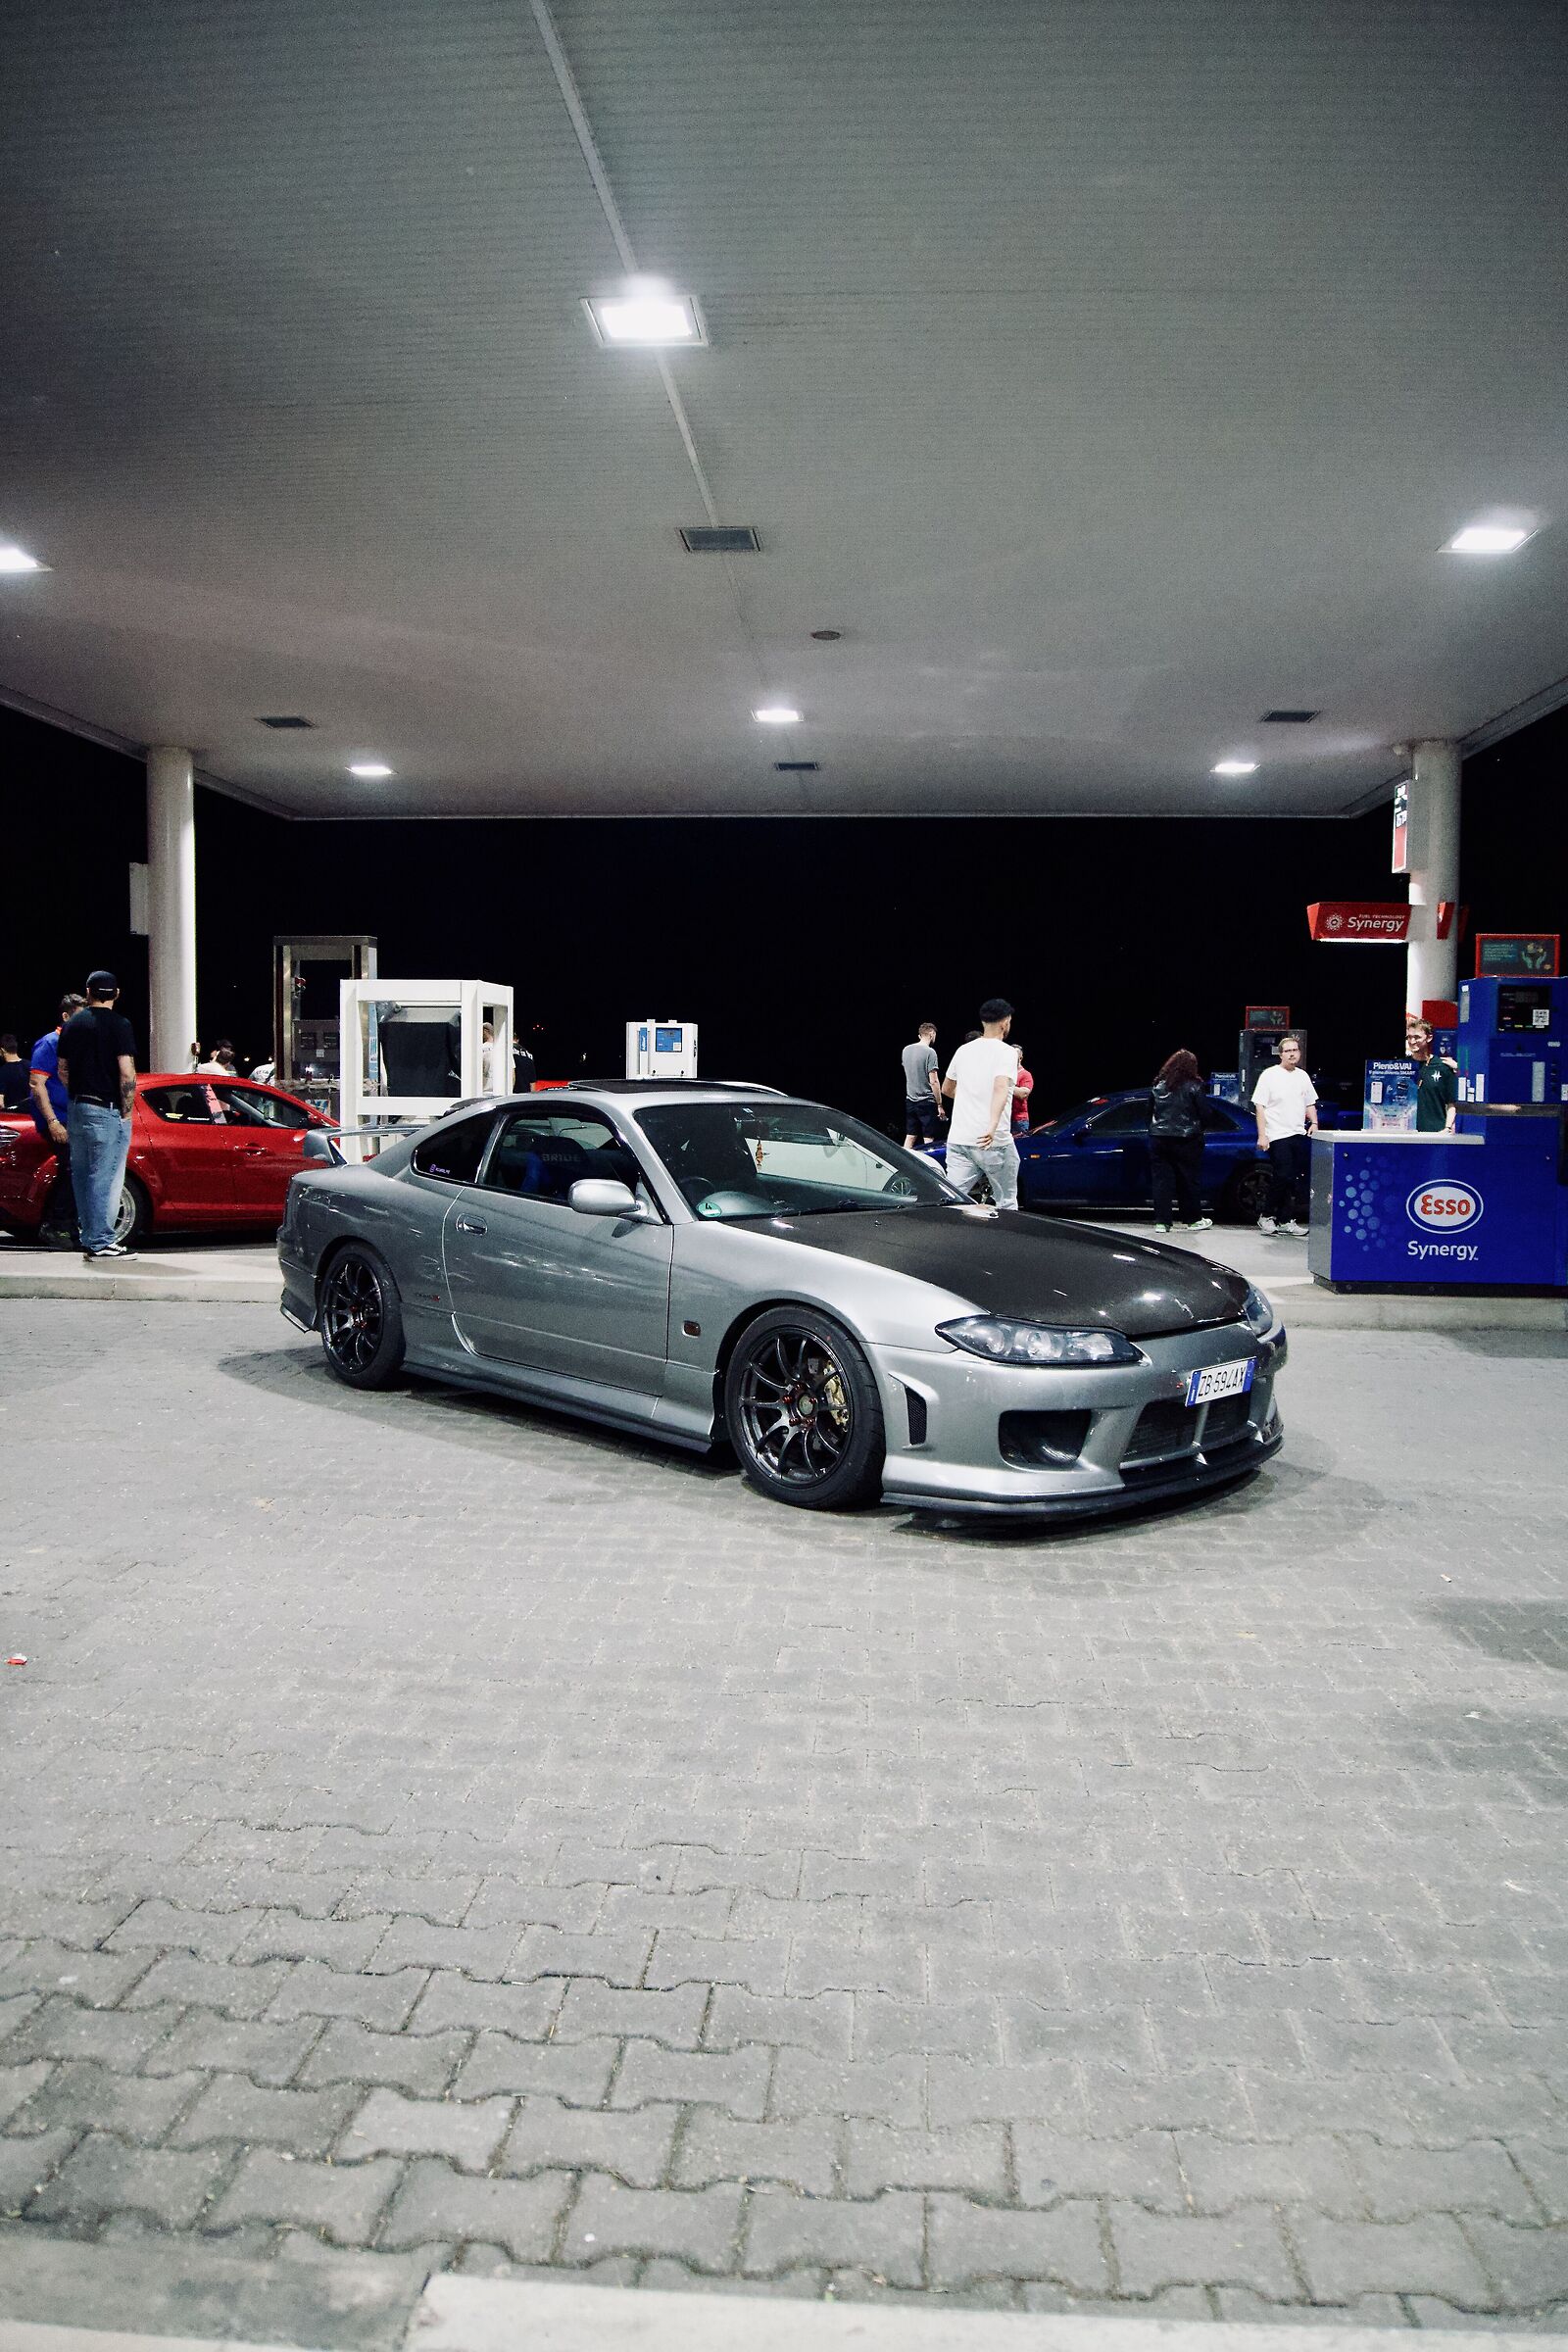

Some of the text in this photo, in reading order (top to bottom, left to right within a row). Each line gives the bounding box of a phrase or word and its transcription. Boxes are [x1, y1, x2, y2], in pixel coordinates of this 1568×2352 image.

[1348, 916, 1404, 932] Synergy
[541, 1153, 581, 1162] BRIDE
[1420, 1194, 1471, 1216] Esso
[1407, 1241, 1478, 1261] Synergy
